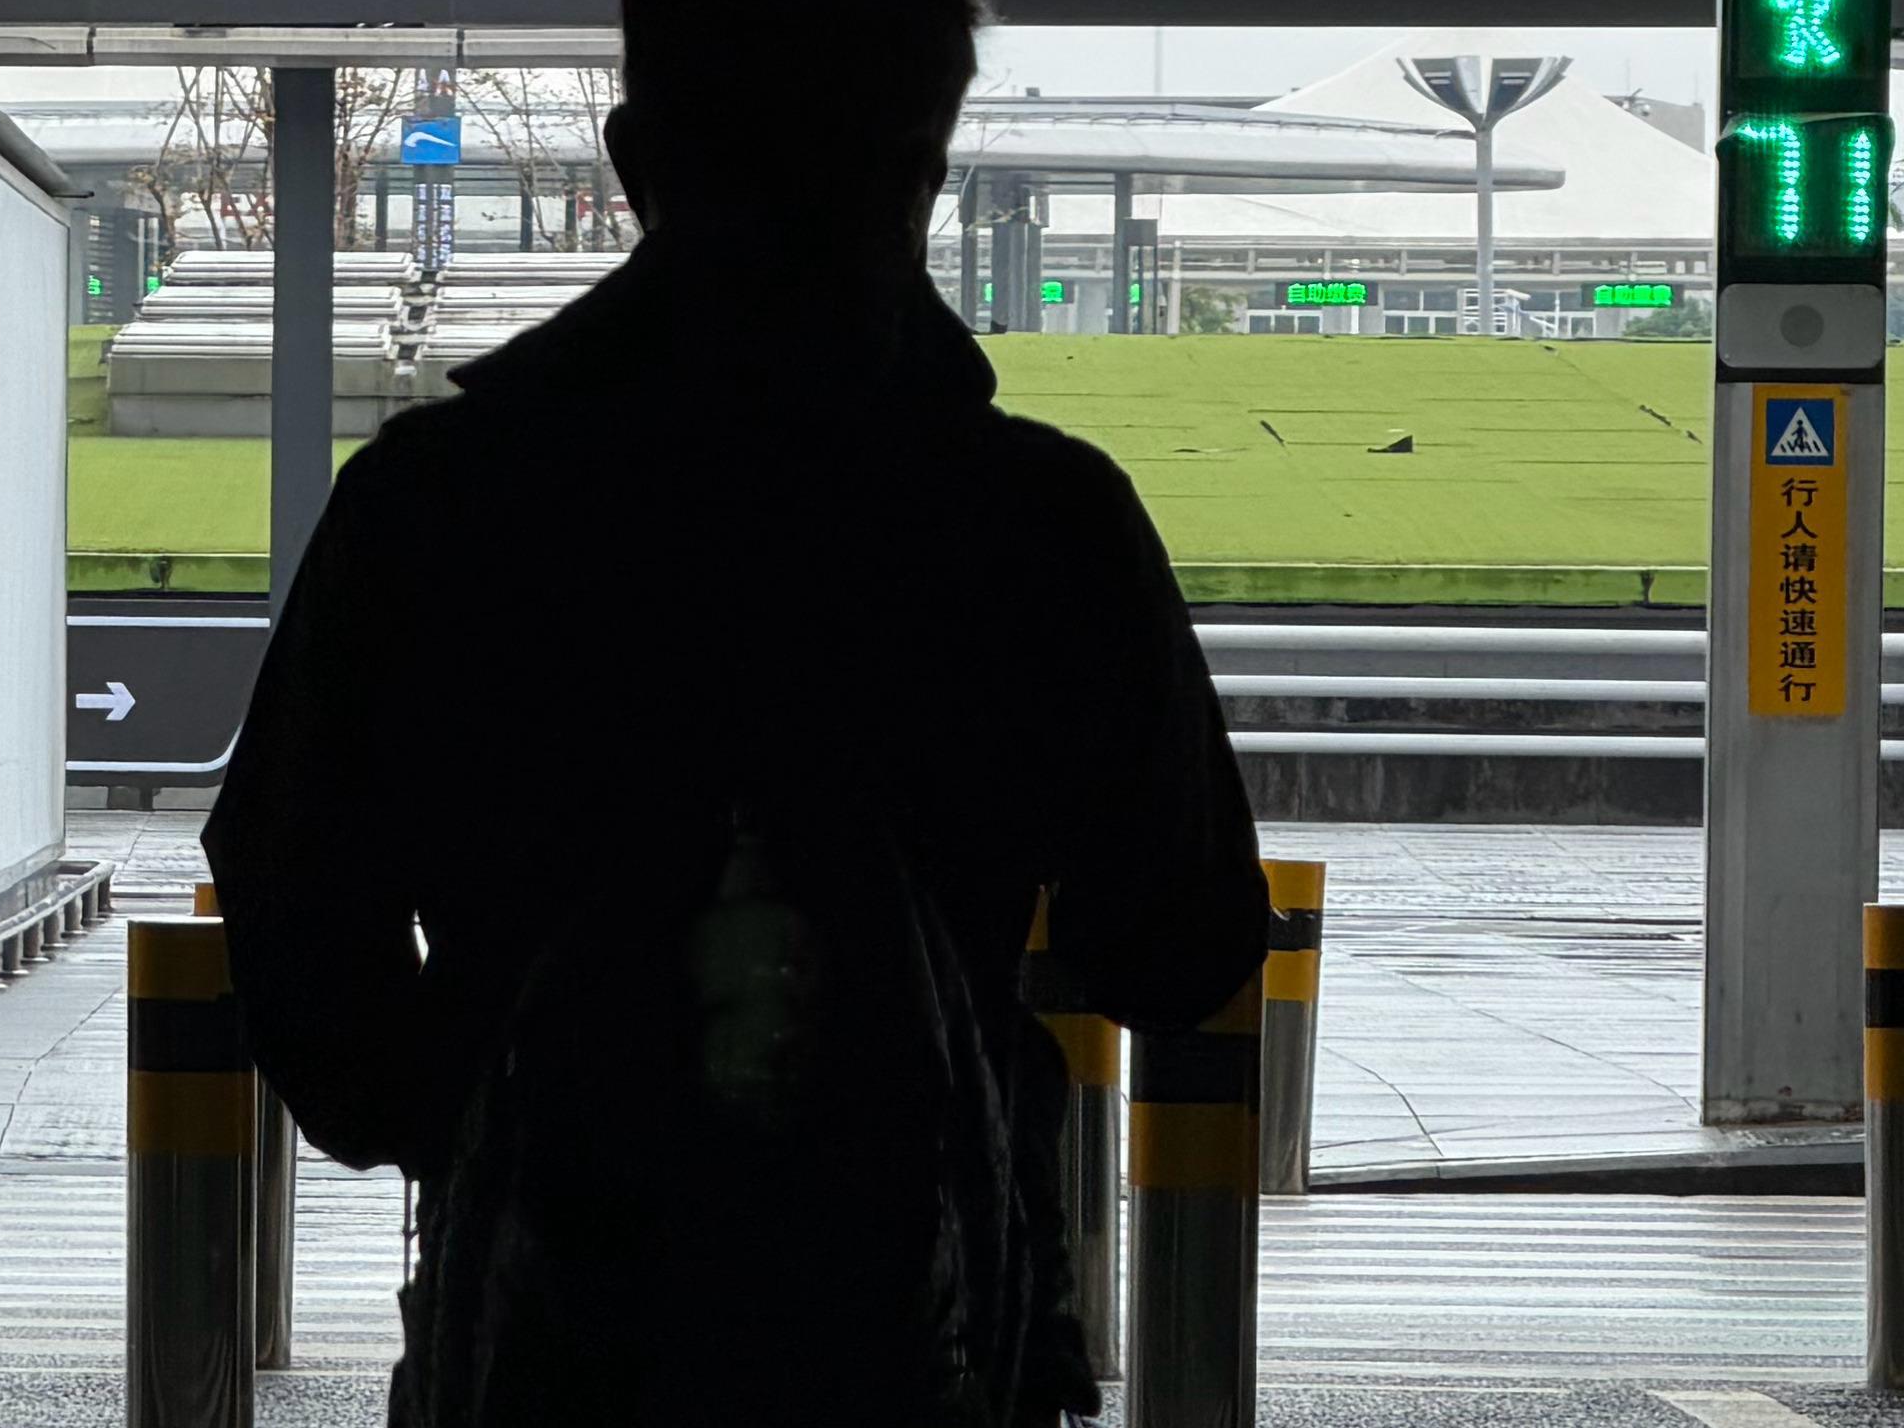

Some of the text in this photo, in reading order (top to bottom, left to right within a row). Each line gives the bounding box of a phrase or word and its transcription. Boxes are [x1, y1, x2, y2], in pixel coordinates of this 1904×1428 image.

[1777, 477, 1820, 703] 行人请快速通行
